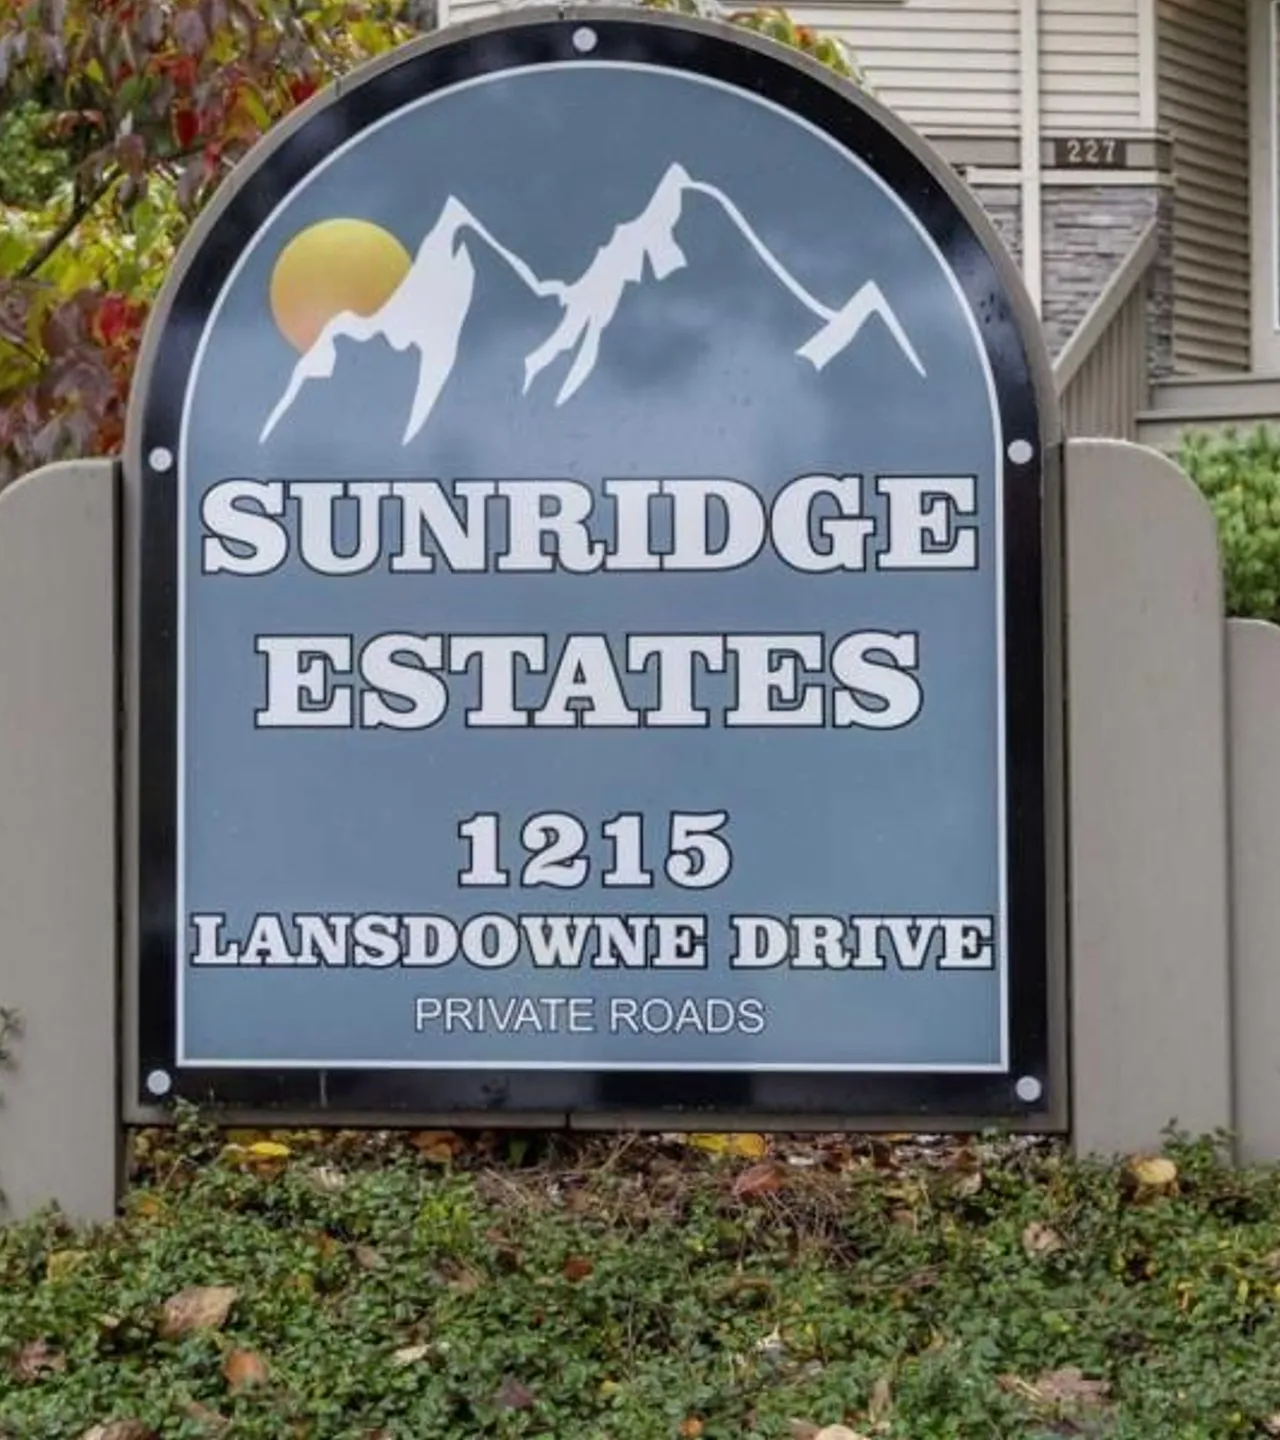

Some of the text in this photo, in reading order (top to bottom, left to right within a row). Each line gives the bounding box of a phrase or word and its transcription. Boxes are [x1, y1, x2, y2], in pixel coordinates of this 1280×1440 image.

[1067, 139, 1116, 163] 227
[201, 474, 980, 574] SUNRIDGE
[254, 631, 924, 730] ESTATES
[457, 810, 733, 888] 1215
[190, 913, 995, 969] LANSDOWNE DRIVE
[414, 996, 767, 1035] PRIVATE ROADS
